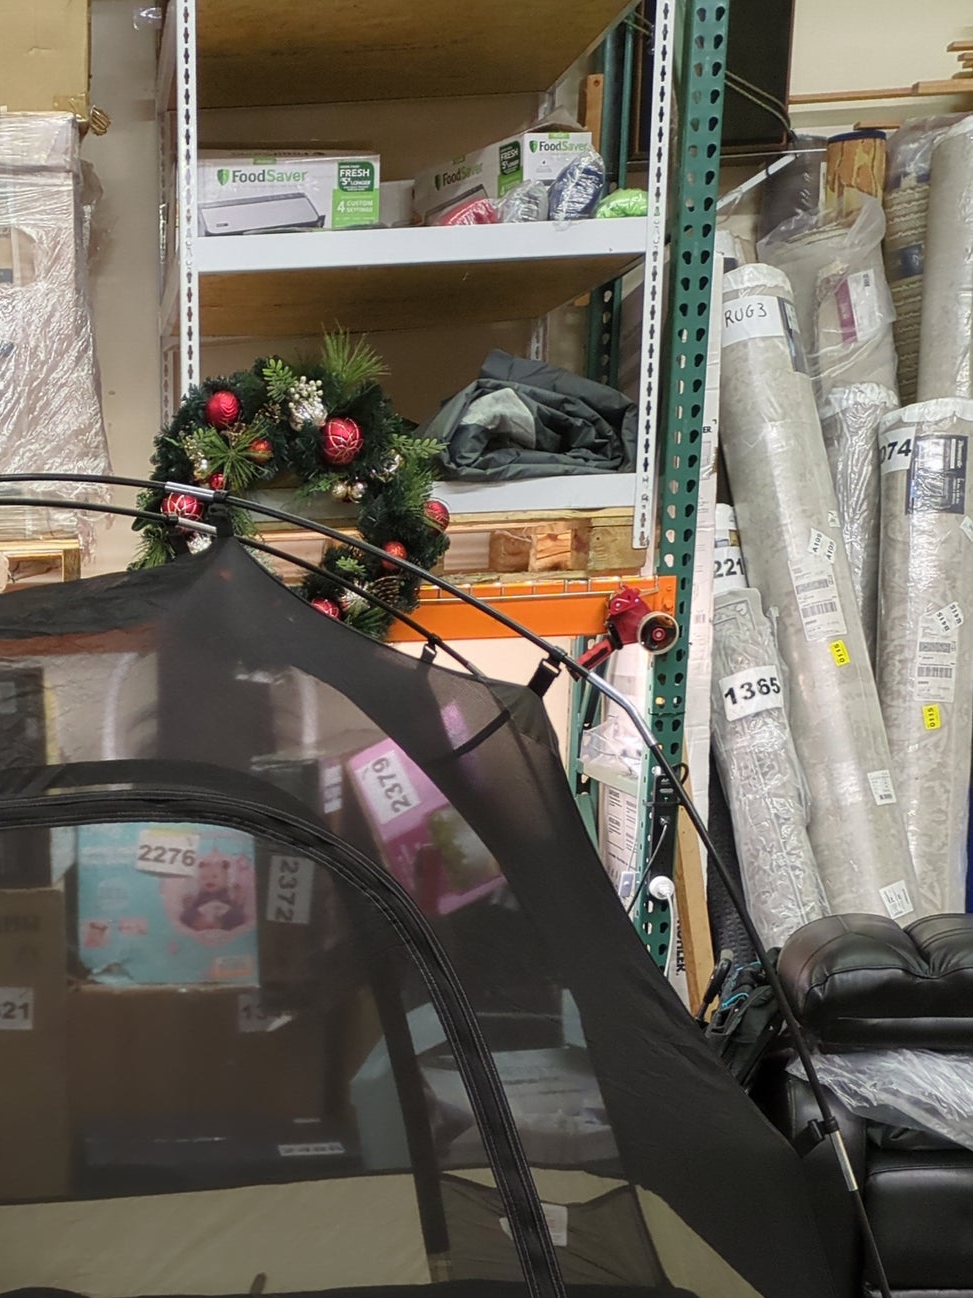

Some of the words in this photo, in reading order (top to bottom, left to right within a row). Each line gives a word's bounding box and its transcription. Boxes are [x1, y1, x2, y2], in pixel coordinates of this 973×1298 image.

[538, 140, 588, 152] FoodSaver
[232, 168, 308, 184] FoodSaver
[339, 168, 371, 177] FRESH
[441, 162, 483, 187] FoodSaver
[337, 200, 346, 213] 4
[724, 676, 781, 705] 1365
[371, 757, 412, 813] 2379
[138, 844, 197, 867] 2276
[276, 859, 299, 922] 2372
